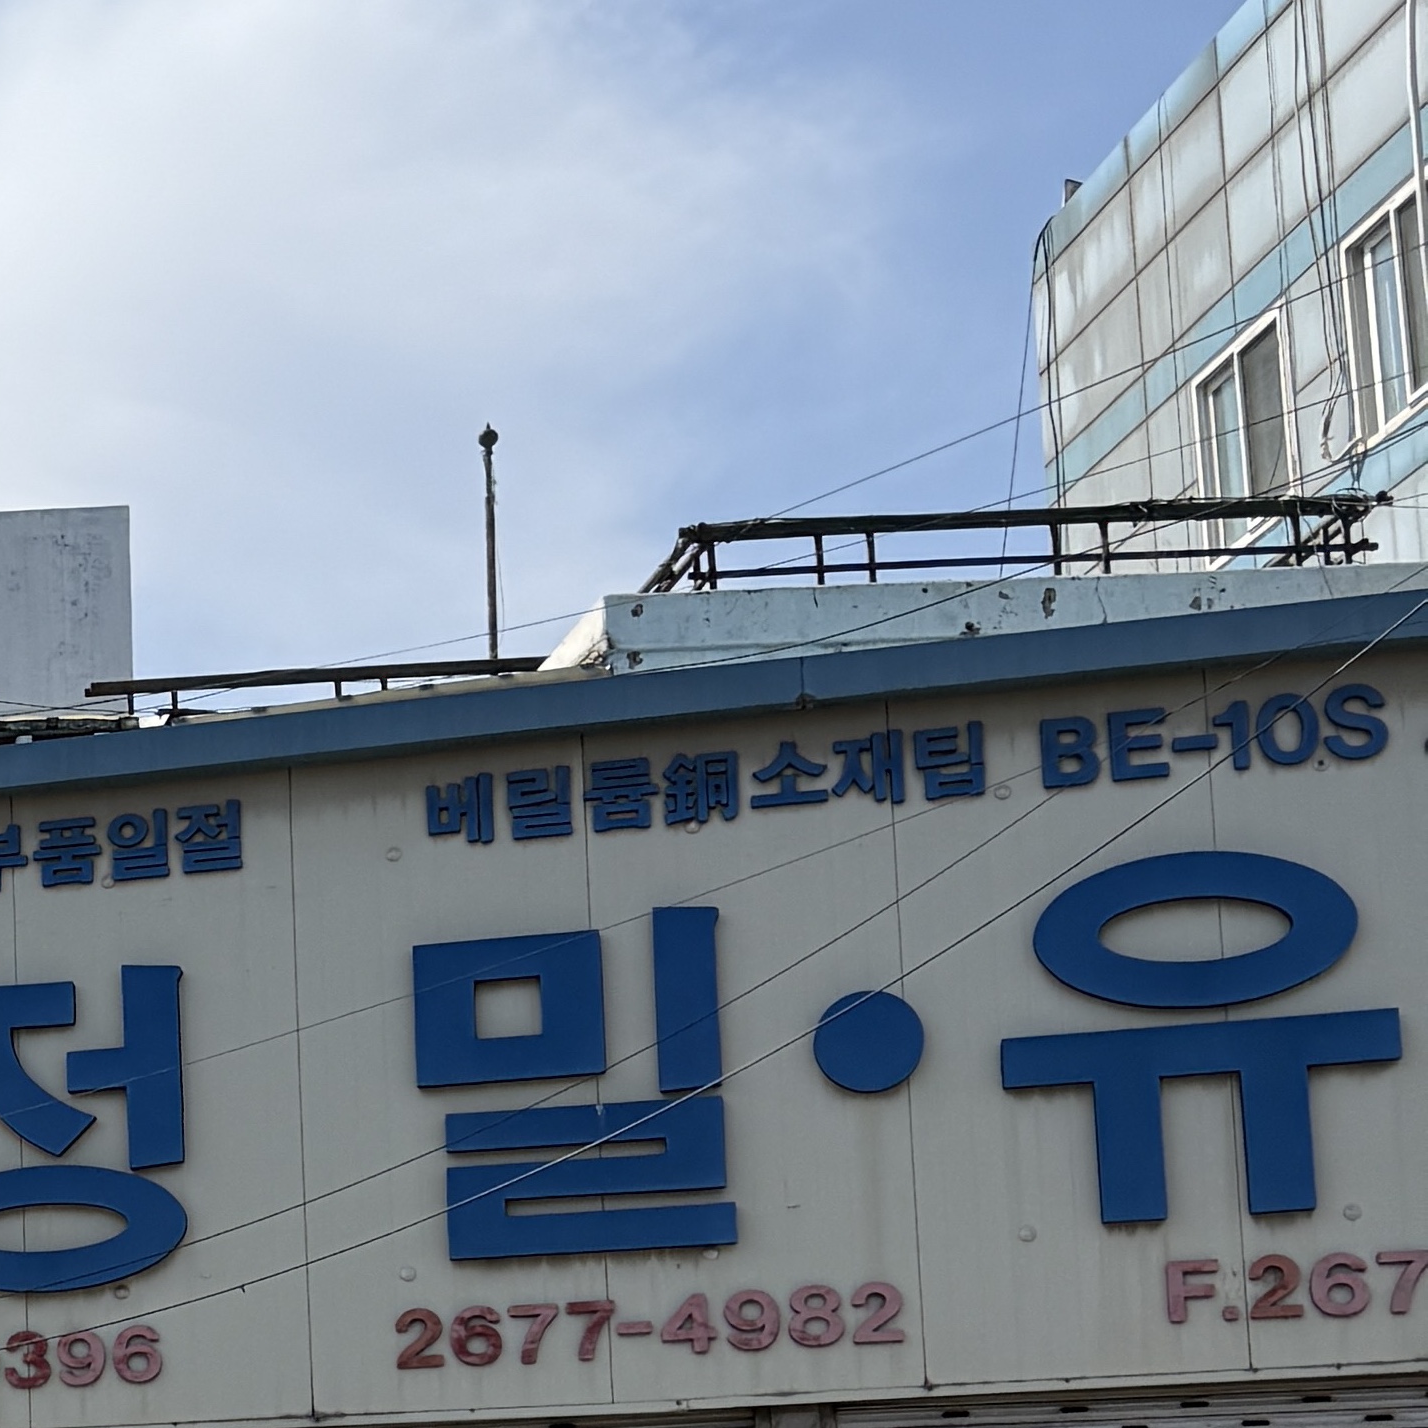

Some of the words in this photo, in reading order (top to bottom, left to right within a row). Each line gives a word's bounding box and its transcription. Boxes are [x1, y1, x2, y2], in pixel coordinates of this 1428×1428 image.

[1039, 683, 1389, 790] BE-10S
[394, 1281, 906, 1370] 2677-4982
[1164, 1250, 1428, 1325] F.267
